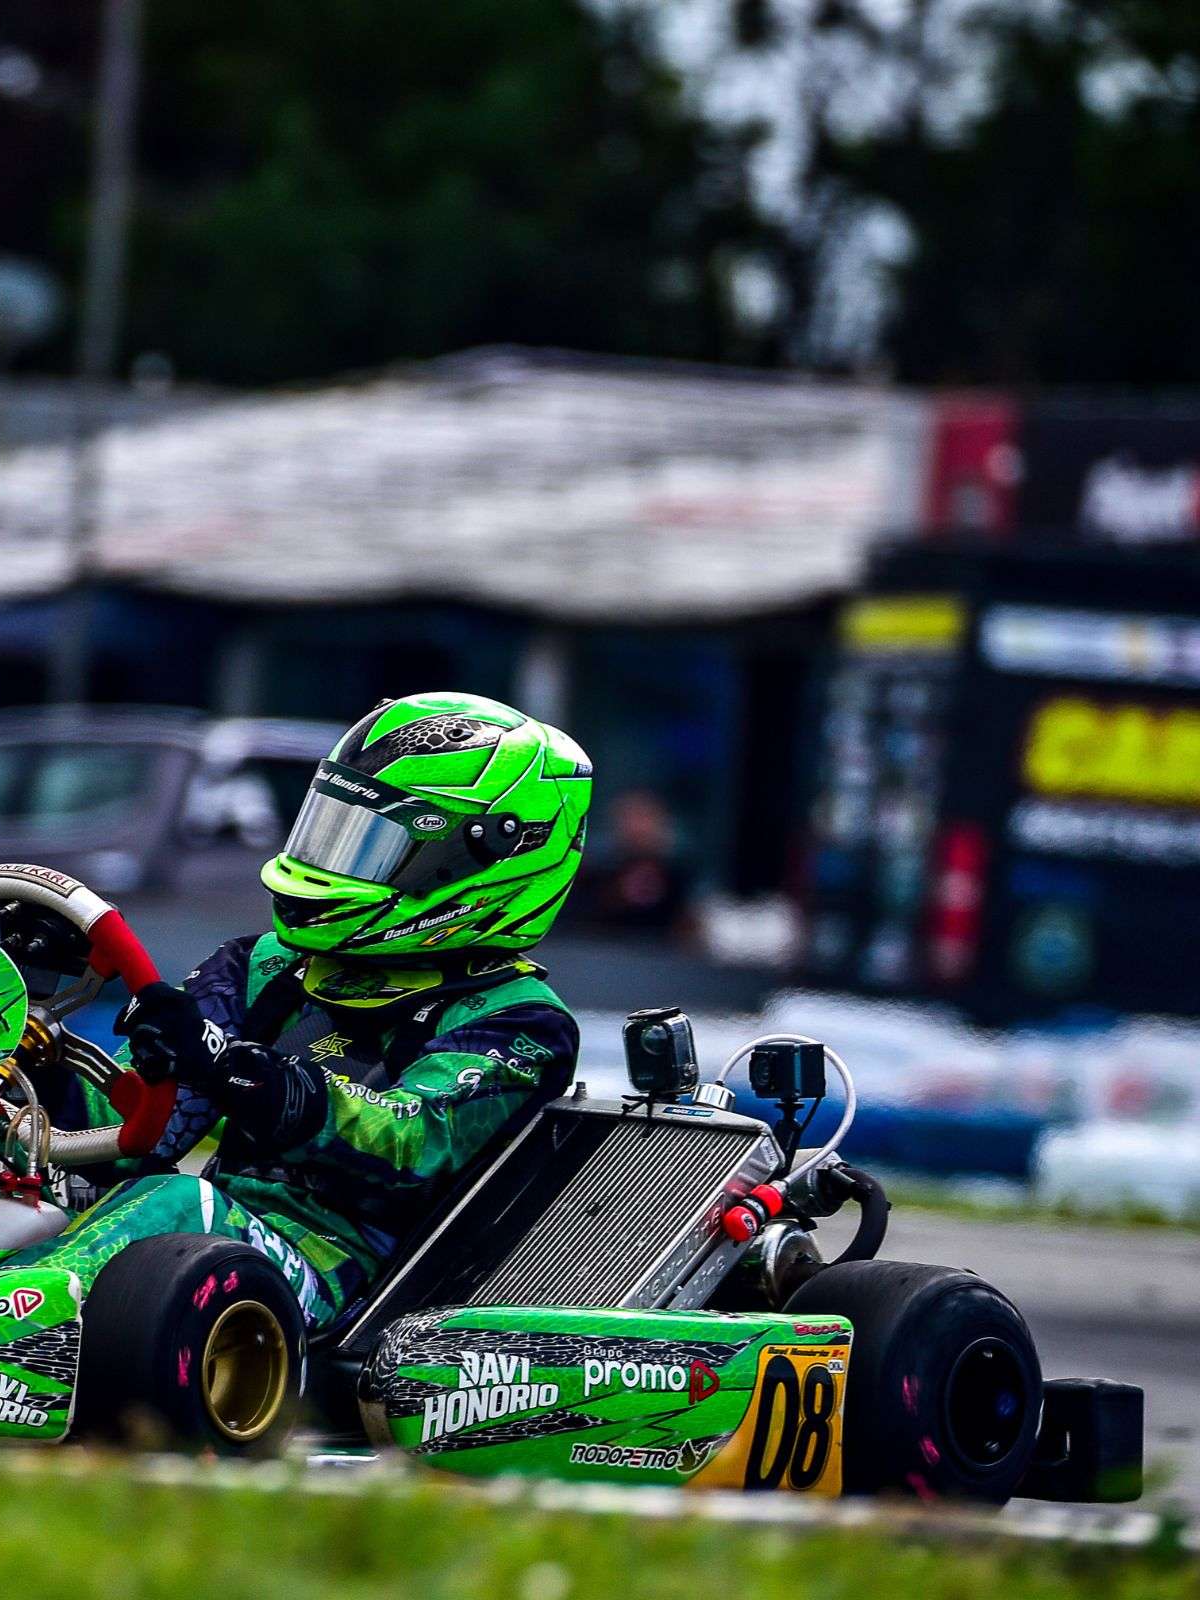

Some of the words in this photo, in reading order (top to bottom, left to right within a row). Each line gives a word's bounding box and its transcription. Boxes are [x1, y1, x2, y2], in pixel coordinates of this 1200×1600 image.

[416, 815, 443, 828] Arai
[459, 1350, 530, 1389] DAVI
[584, 1358, 687, 1397] promo
[421, 1383, 560, 1443] HONORIO
[745, 1356, 836, 1491] 08
[570, 1443, 679, 1469] RODOPETRO
